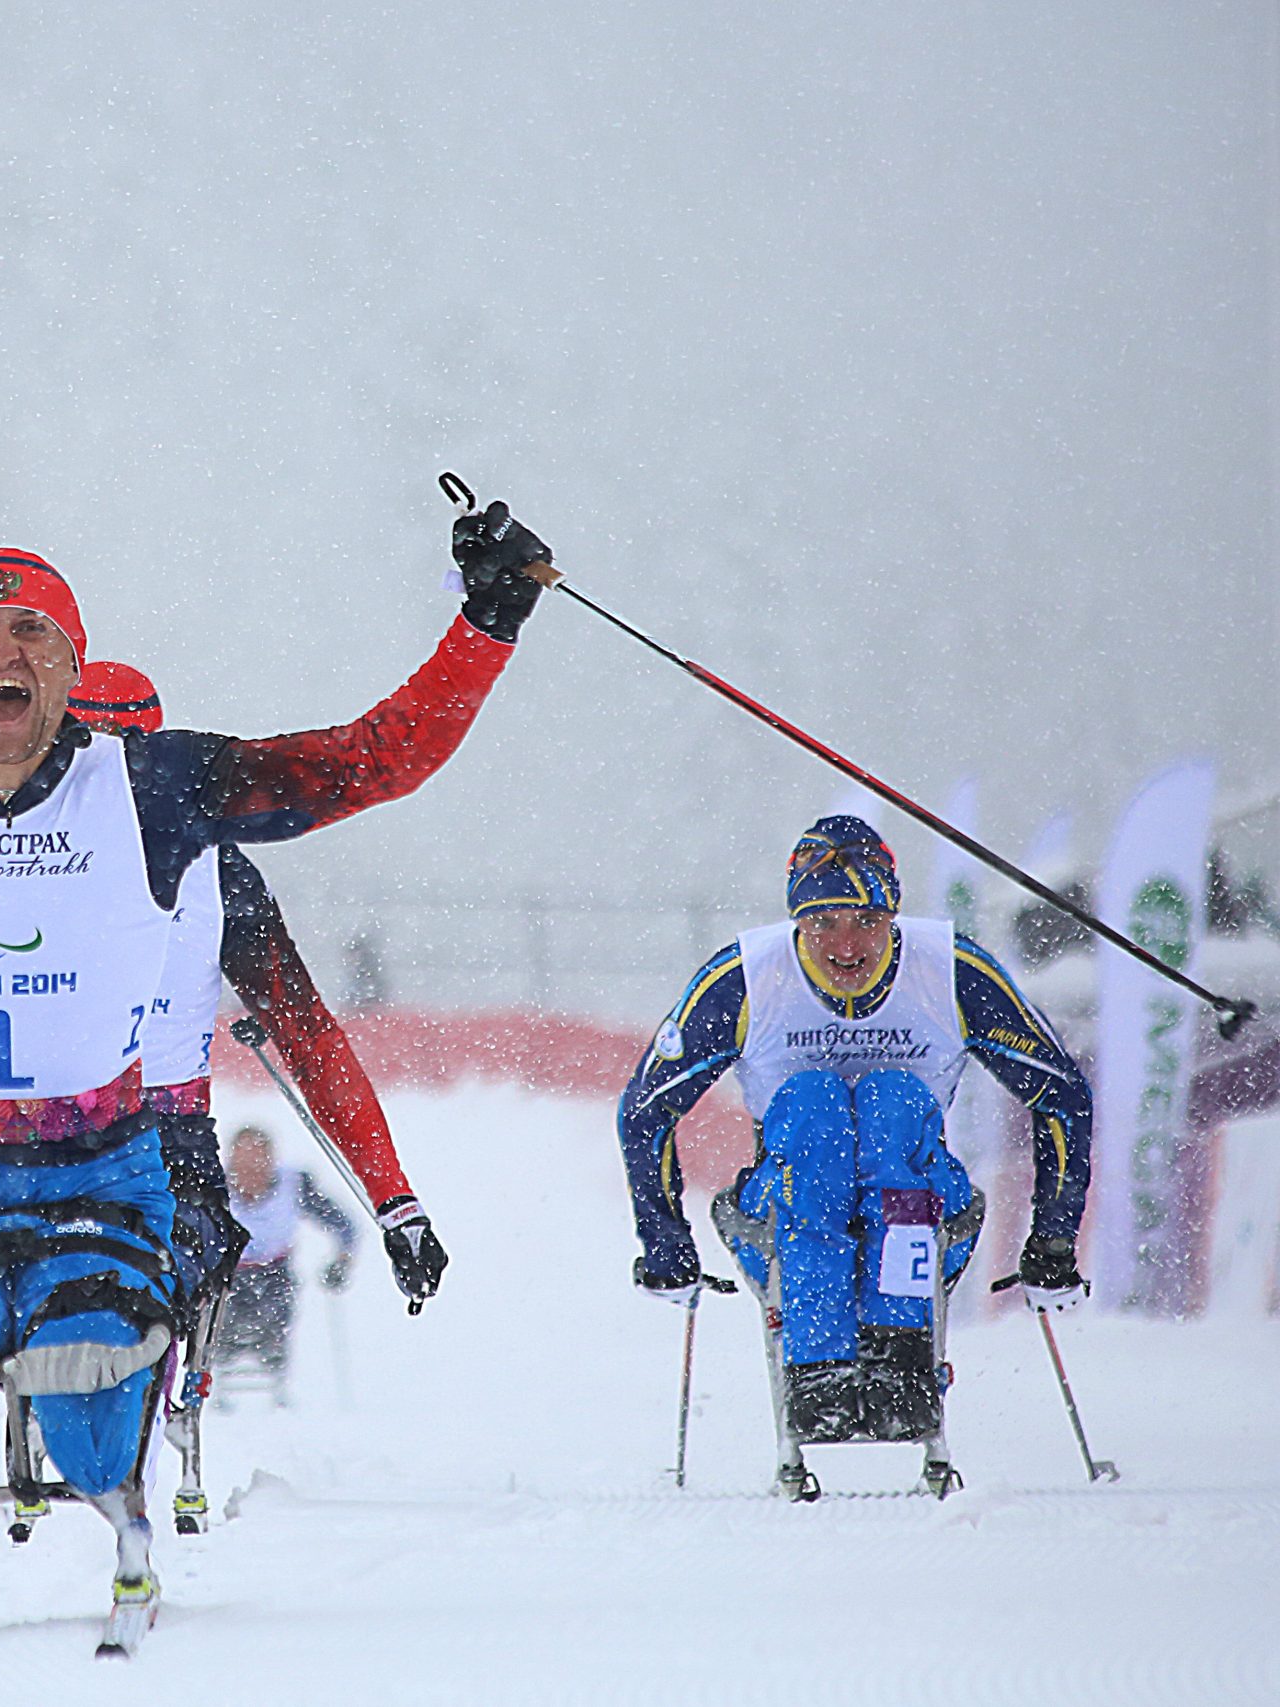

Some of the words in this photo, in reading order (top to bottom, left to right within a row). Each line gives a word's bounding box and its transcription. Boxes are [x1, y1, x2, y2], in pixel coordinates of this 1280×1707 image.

[12, 972, 77, 995] 2014
[151, 998, 171, 1014] 14
[786, 1023, 914, 1048] ИНГОССТРАХ
[56, 1222, 103, 1235] adidas
[910, 1241, 929, 1281] 2
